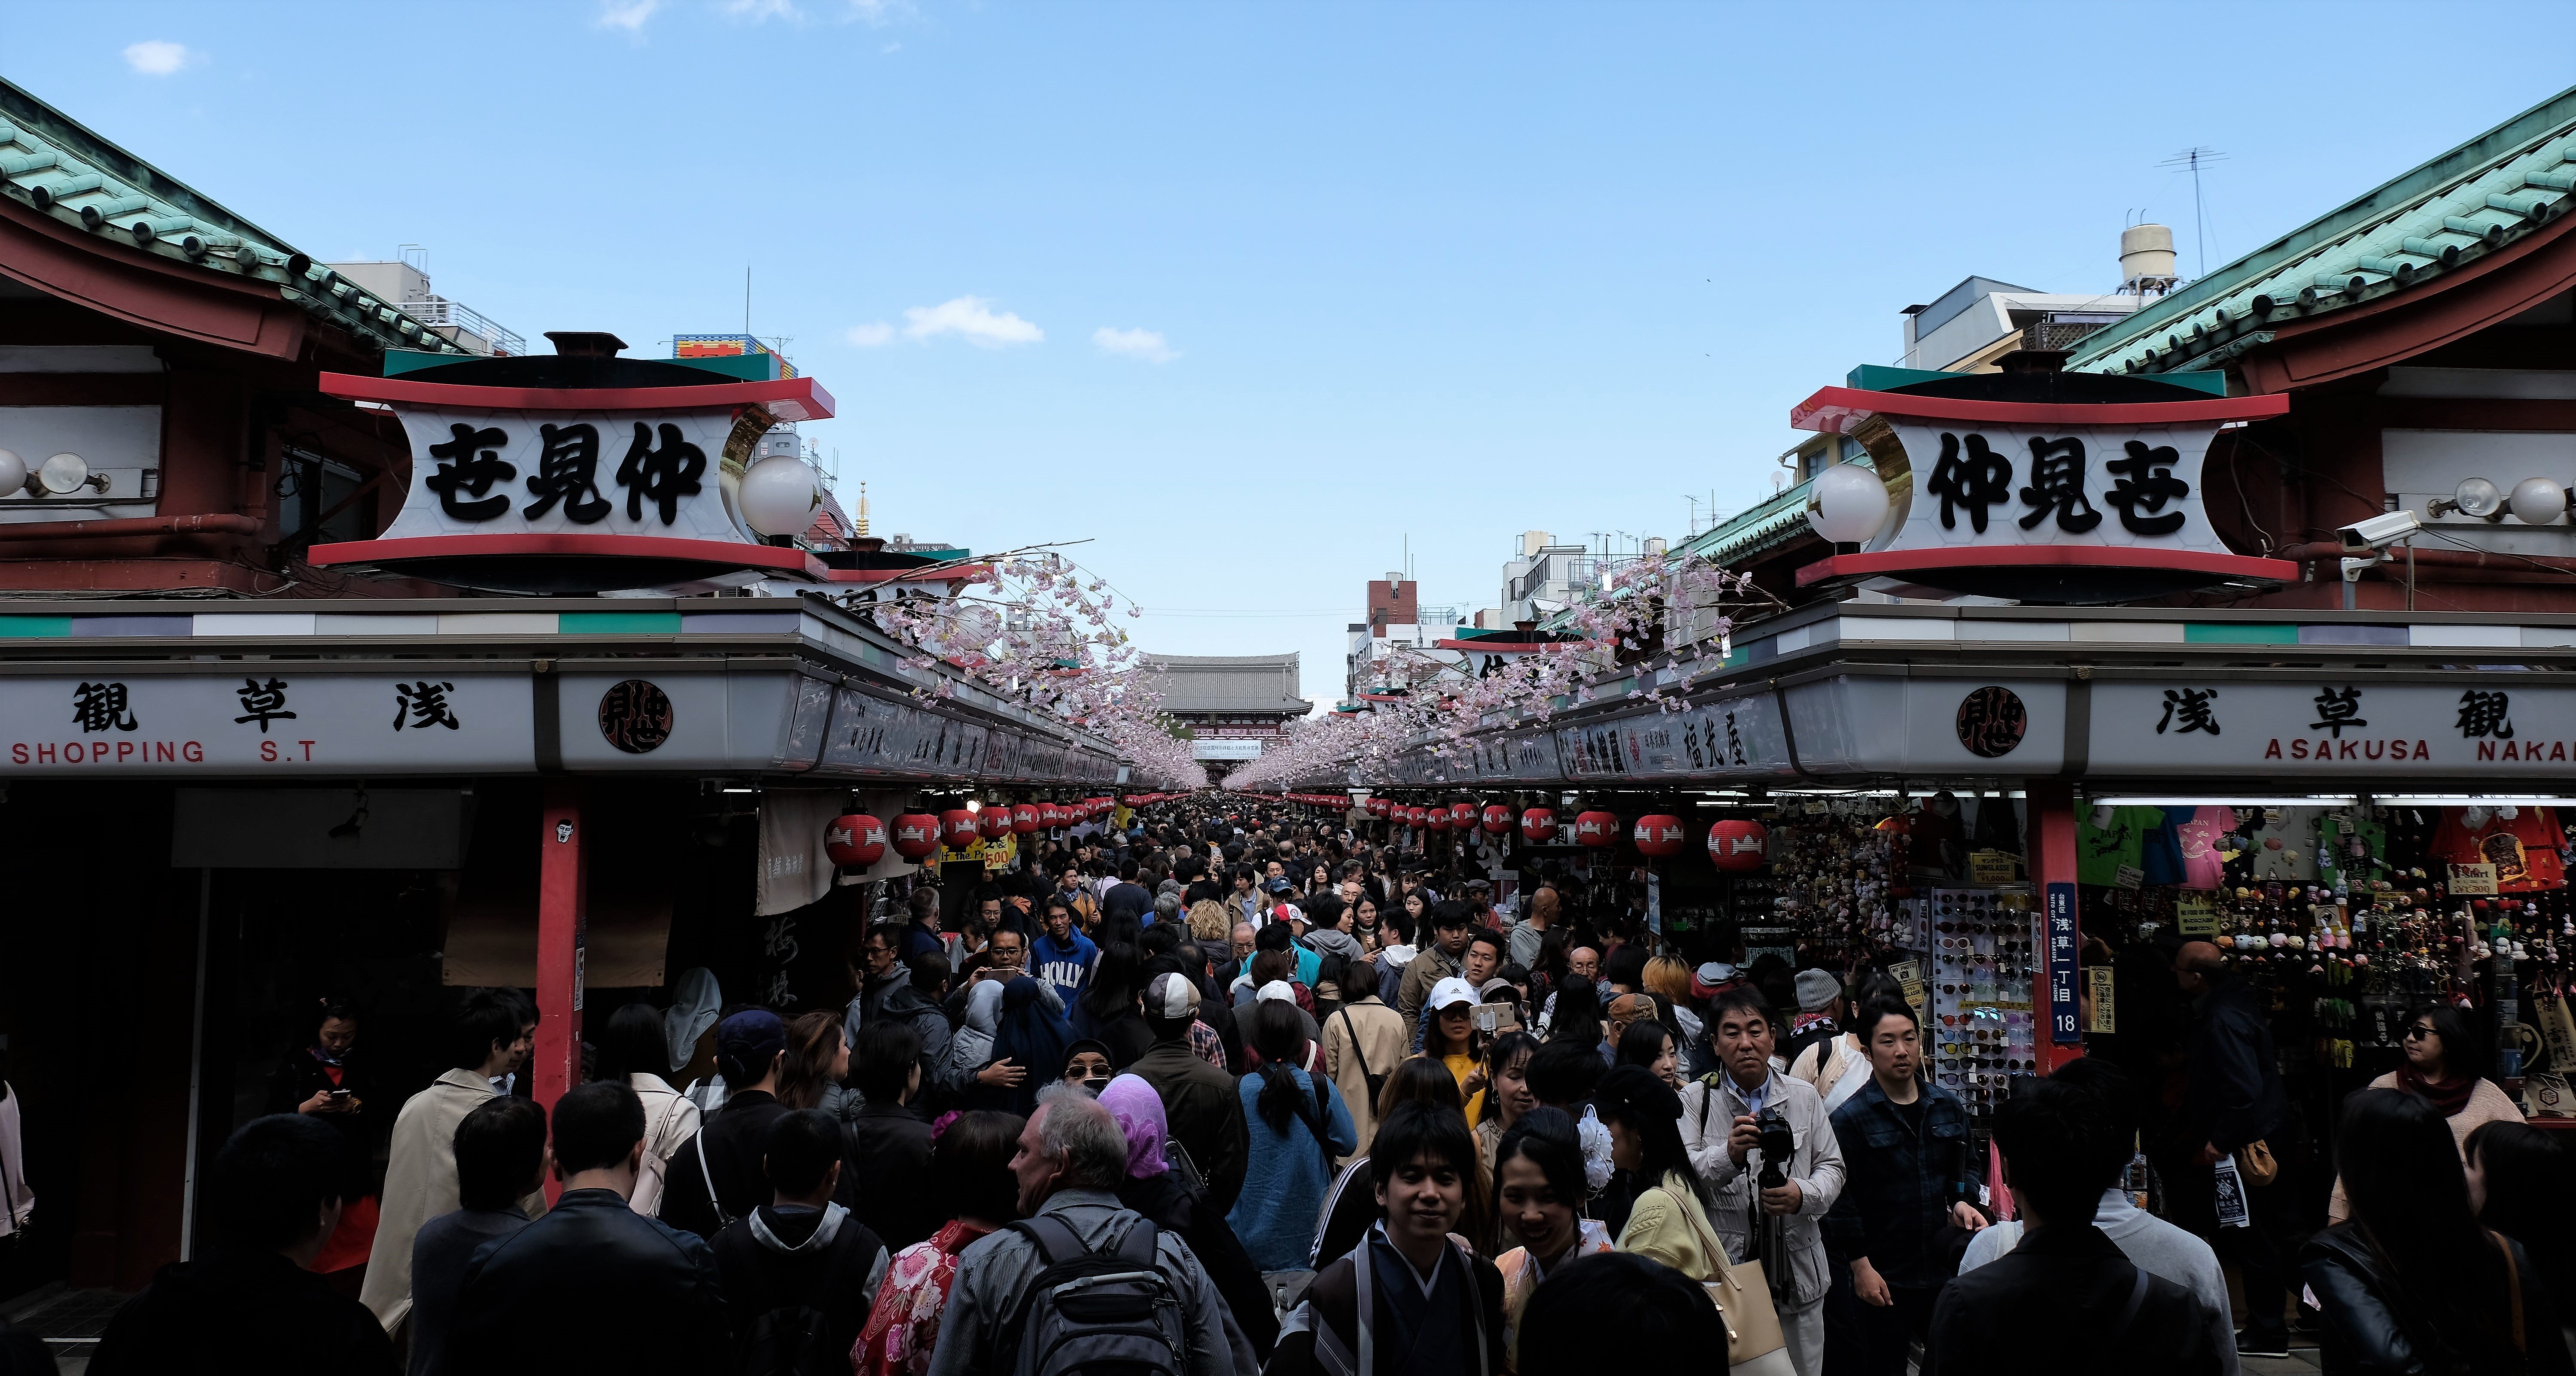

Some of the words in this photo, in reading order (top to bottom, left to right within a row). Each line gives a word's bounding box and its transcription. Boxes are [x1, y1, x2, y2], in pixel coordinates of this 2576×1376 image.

[1928, 432, 2190, 538] 仲見世
[12, 741, 204, 763] SHOPPING
[261, 741, 315, 762] S.T
[1684, 710, 1748, 770] 福光屋
[2265, 738, 2430, 760] ASAKUSA
[2478, 741, 2576, 762] NAKA
[955, 852, 971, 860] the
[985, 850, 1009, 868] 500
[2056, 918, 2070, 1002] 浅草一丁目
[1040, 961, 1084, 989] HOLLY
[2057, 1015, 2074, 1031] 18
[2547, 1028, 2569, 1061] 雷門
